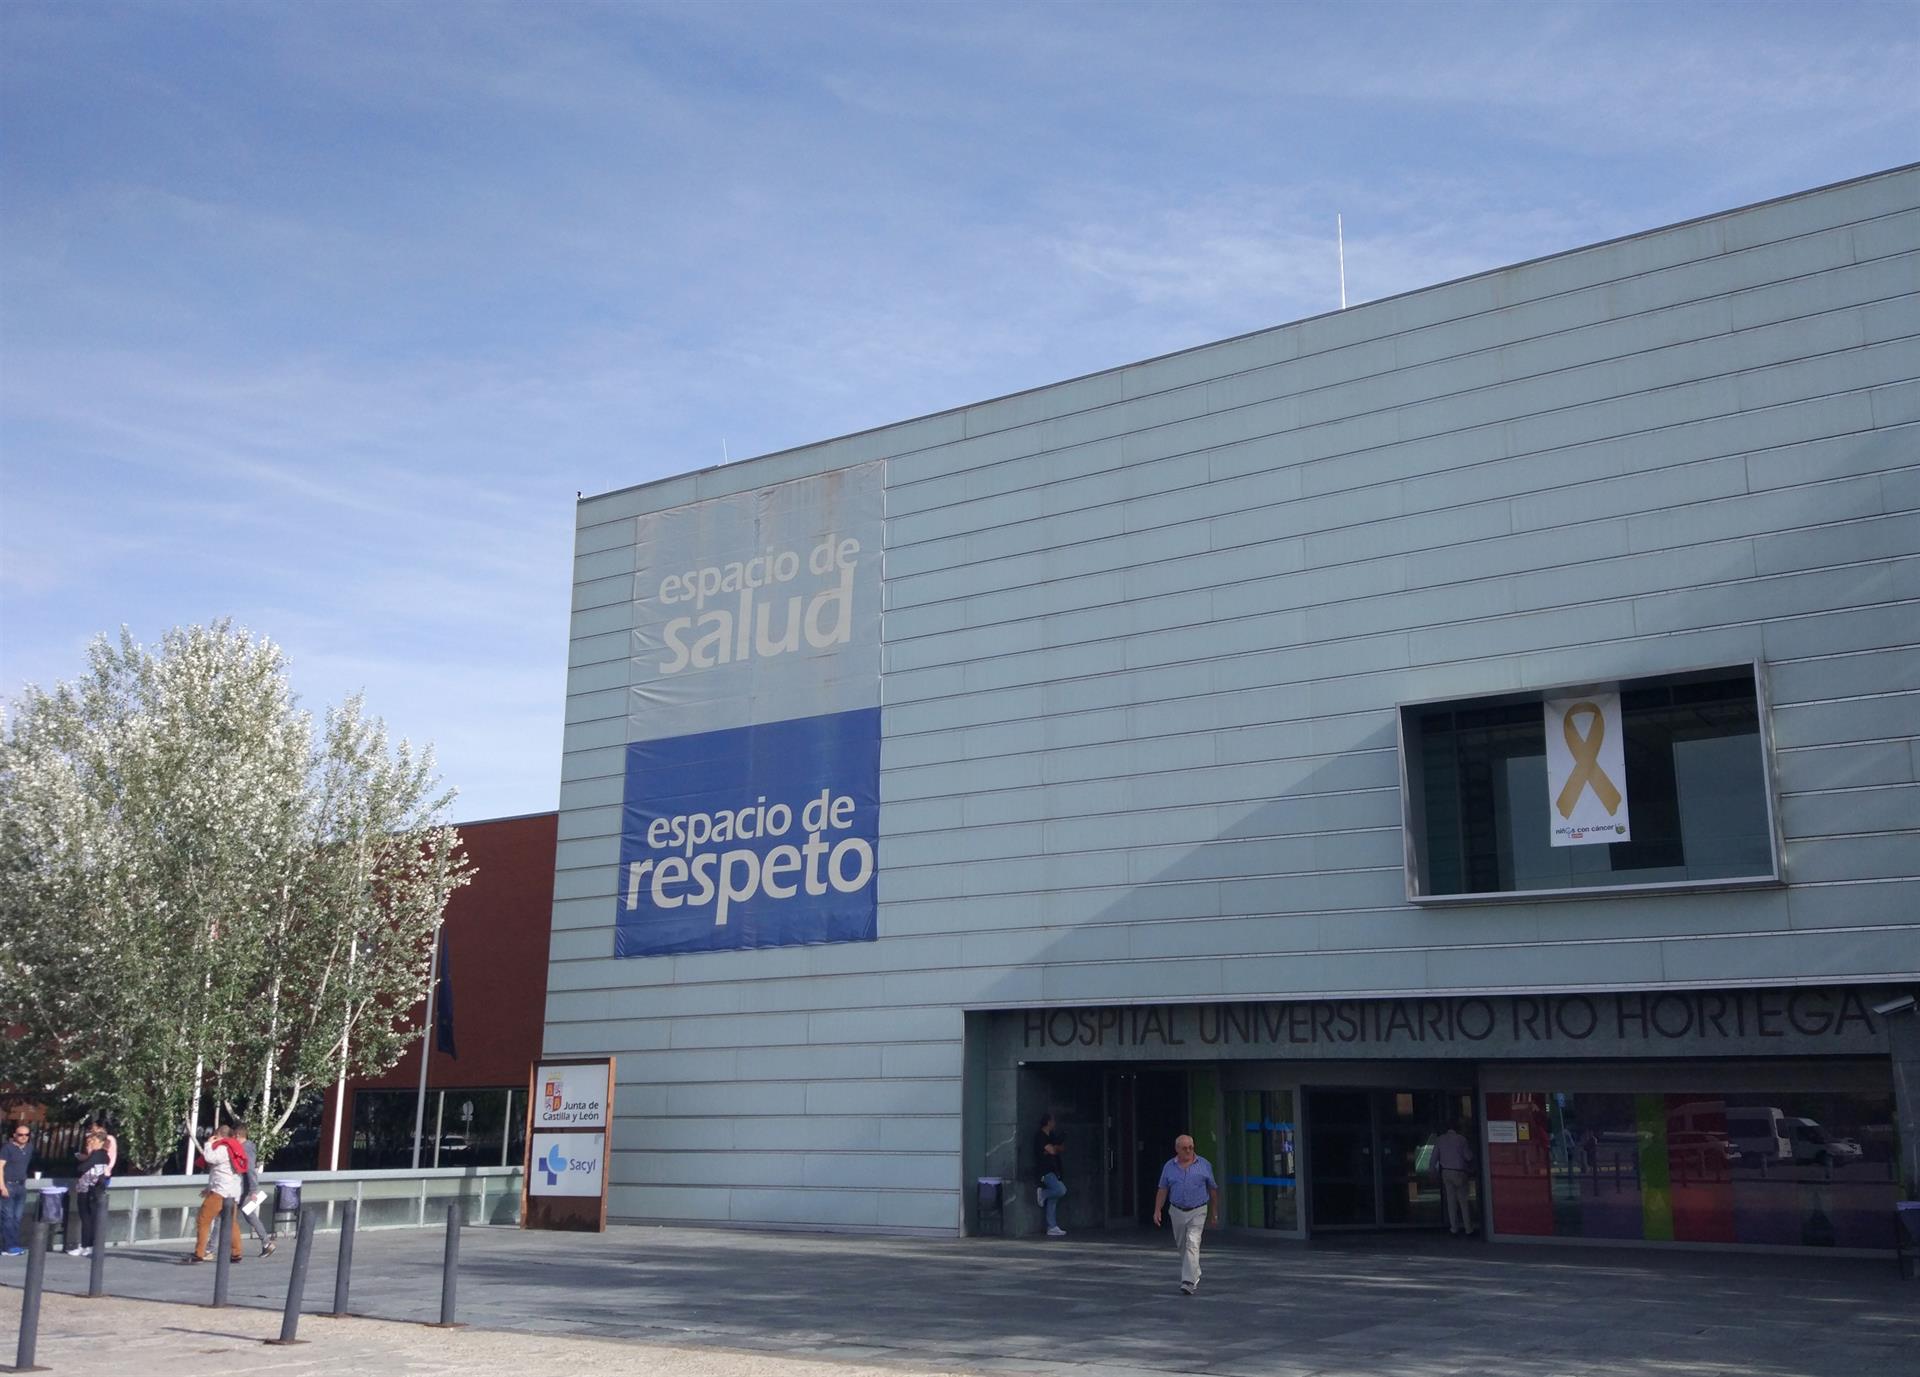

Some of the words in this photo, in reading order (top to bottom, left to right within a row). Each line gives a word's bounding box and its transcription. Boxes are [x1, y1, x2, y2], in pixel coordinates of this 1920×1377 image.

[659, 543, 799, 608] espacio
[808, 534, 860, 576] de
[659, 566, 855, 674] salud
[647, 796, 792, 857] espacio
[802, 789, 856, 832] de
[625, 831, 875, 925] respeto
[1023, 1005, 1184, 1047] HOSPITAL
[1198, 998, 1495, 1044] UNIVERSITARIO
[1512, 994, 1598, 1040] RIO
[1616, 986, 1877, 1038] HORTEGA
[542, 1112, 571, 1121] Castilla
[572, 1113, 578, 1123] y
[579, 1111, 599, 1121] León
[563, 1101, 586, 1110] Junta
[588, 1101, 599, 1110] de
[569, 1158, 596, 1174] Sacyl
